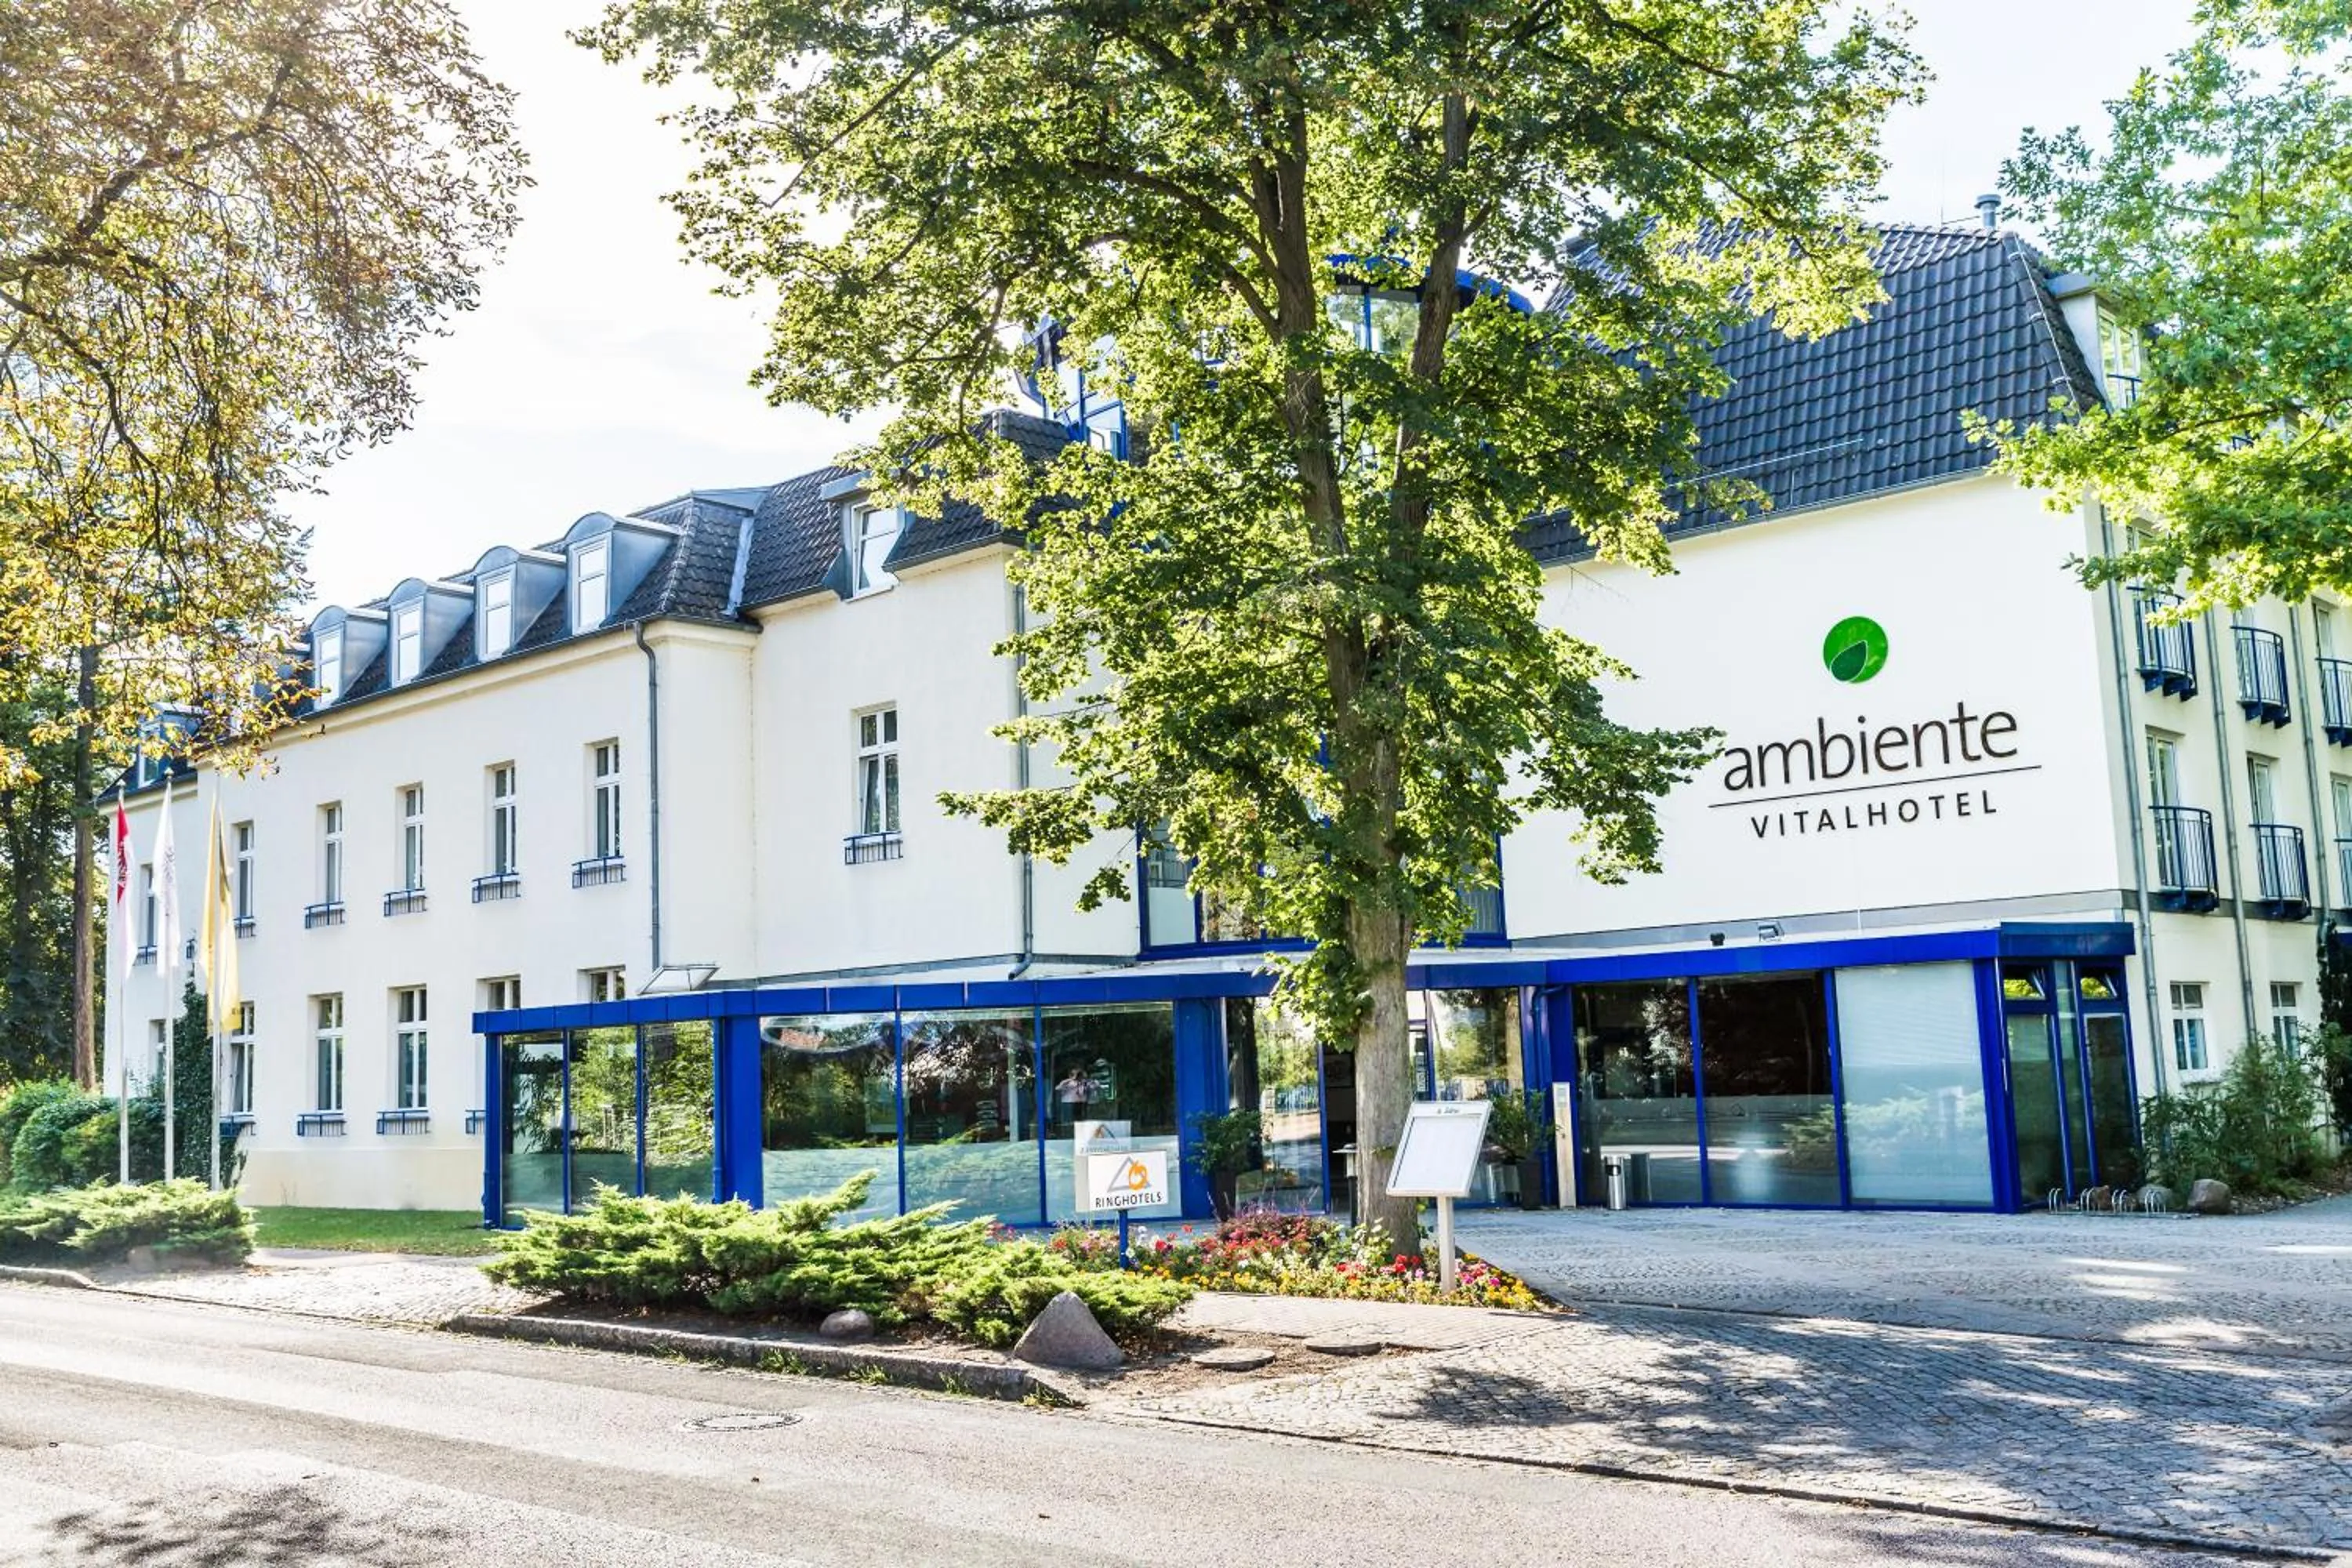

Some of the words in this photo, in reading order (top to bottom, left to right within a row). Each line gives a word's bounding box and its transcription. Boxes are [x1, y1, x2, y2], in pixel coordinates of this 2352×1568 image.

[1723, 701, 2018, 792] ambiente
[1751, 789, 1997, 838] VITALHOTEL
[1095, 1192, 1162, 1208] RINGHOTELS
